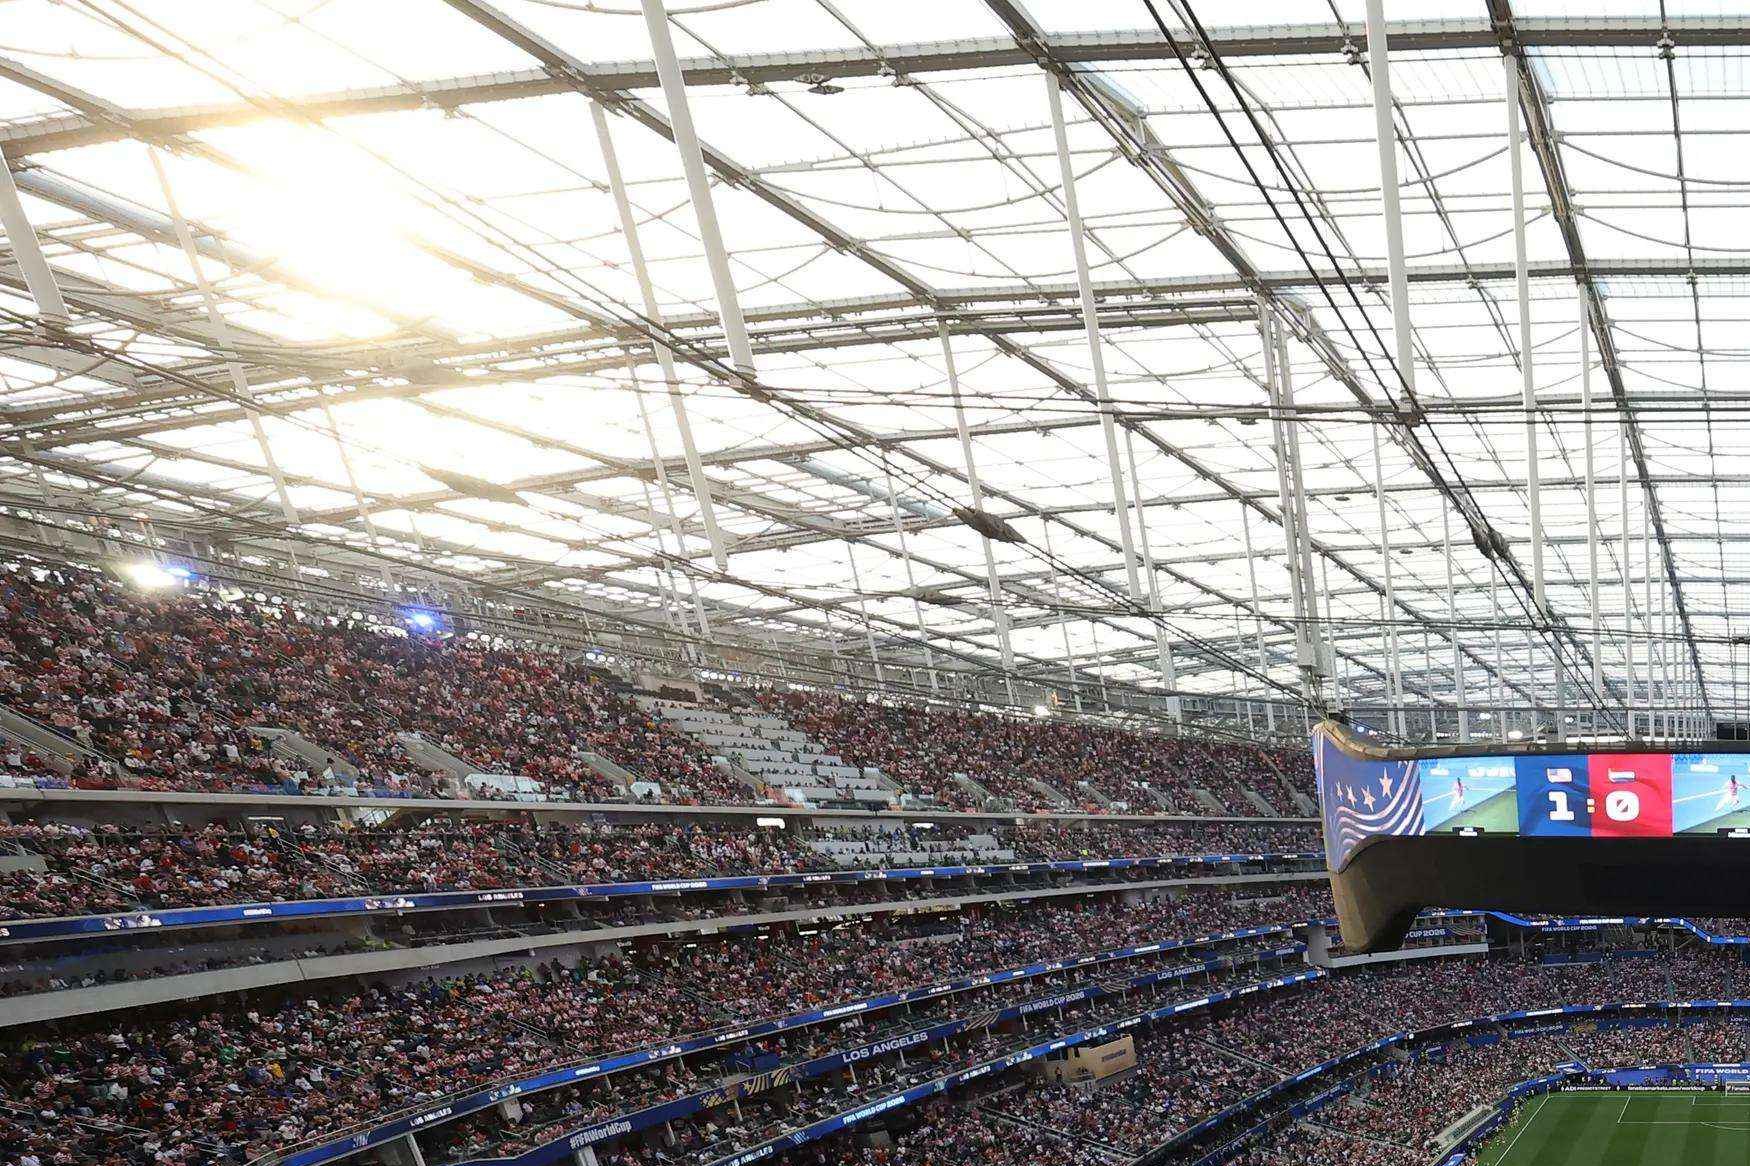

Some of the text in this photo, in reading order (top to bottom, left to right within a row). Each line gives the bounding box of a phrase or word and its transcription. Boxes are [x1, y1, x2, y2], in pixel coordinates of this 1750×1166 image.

[1548, 791, 1574, 821] 1
[1605, 790, 1640, 821] 0
[843, 1032, 928, 1062] LOS ANGELES
[570, 1121, 632, 1149] #FIFAWorldCup
